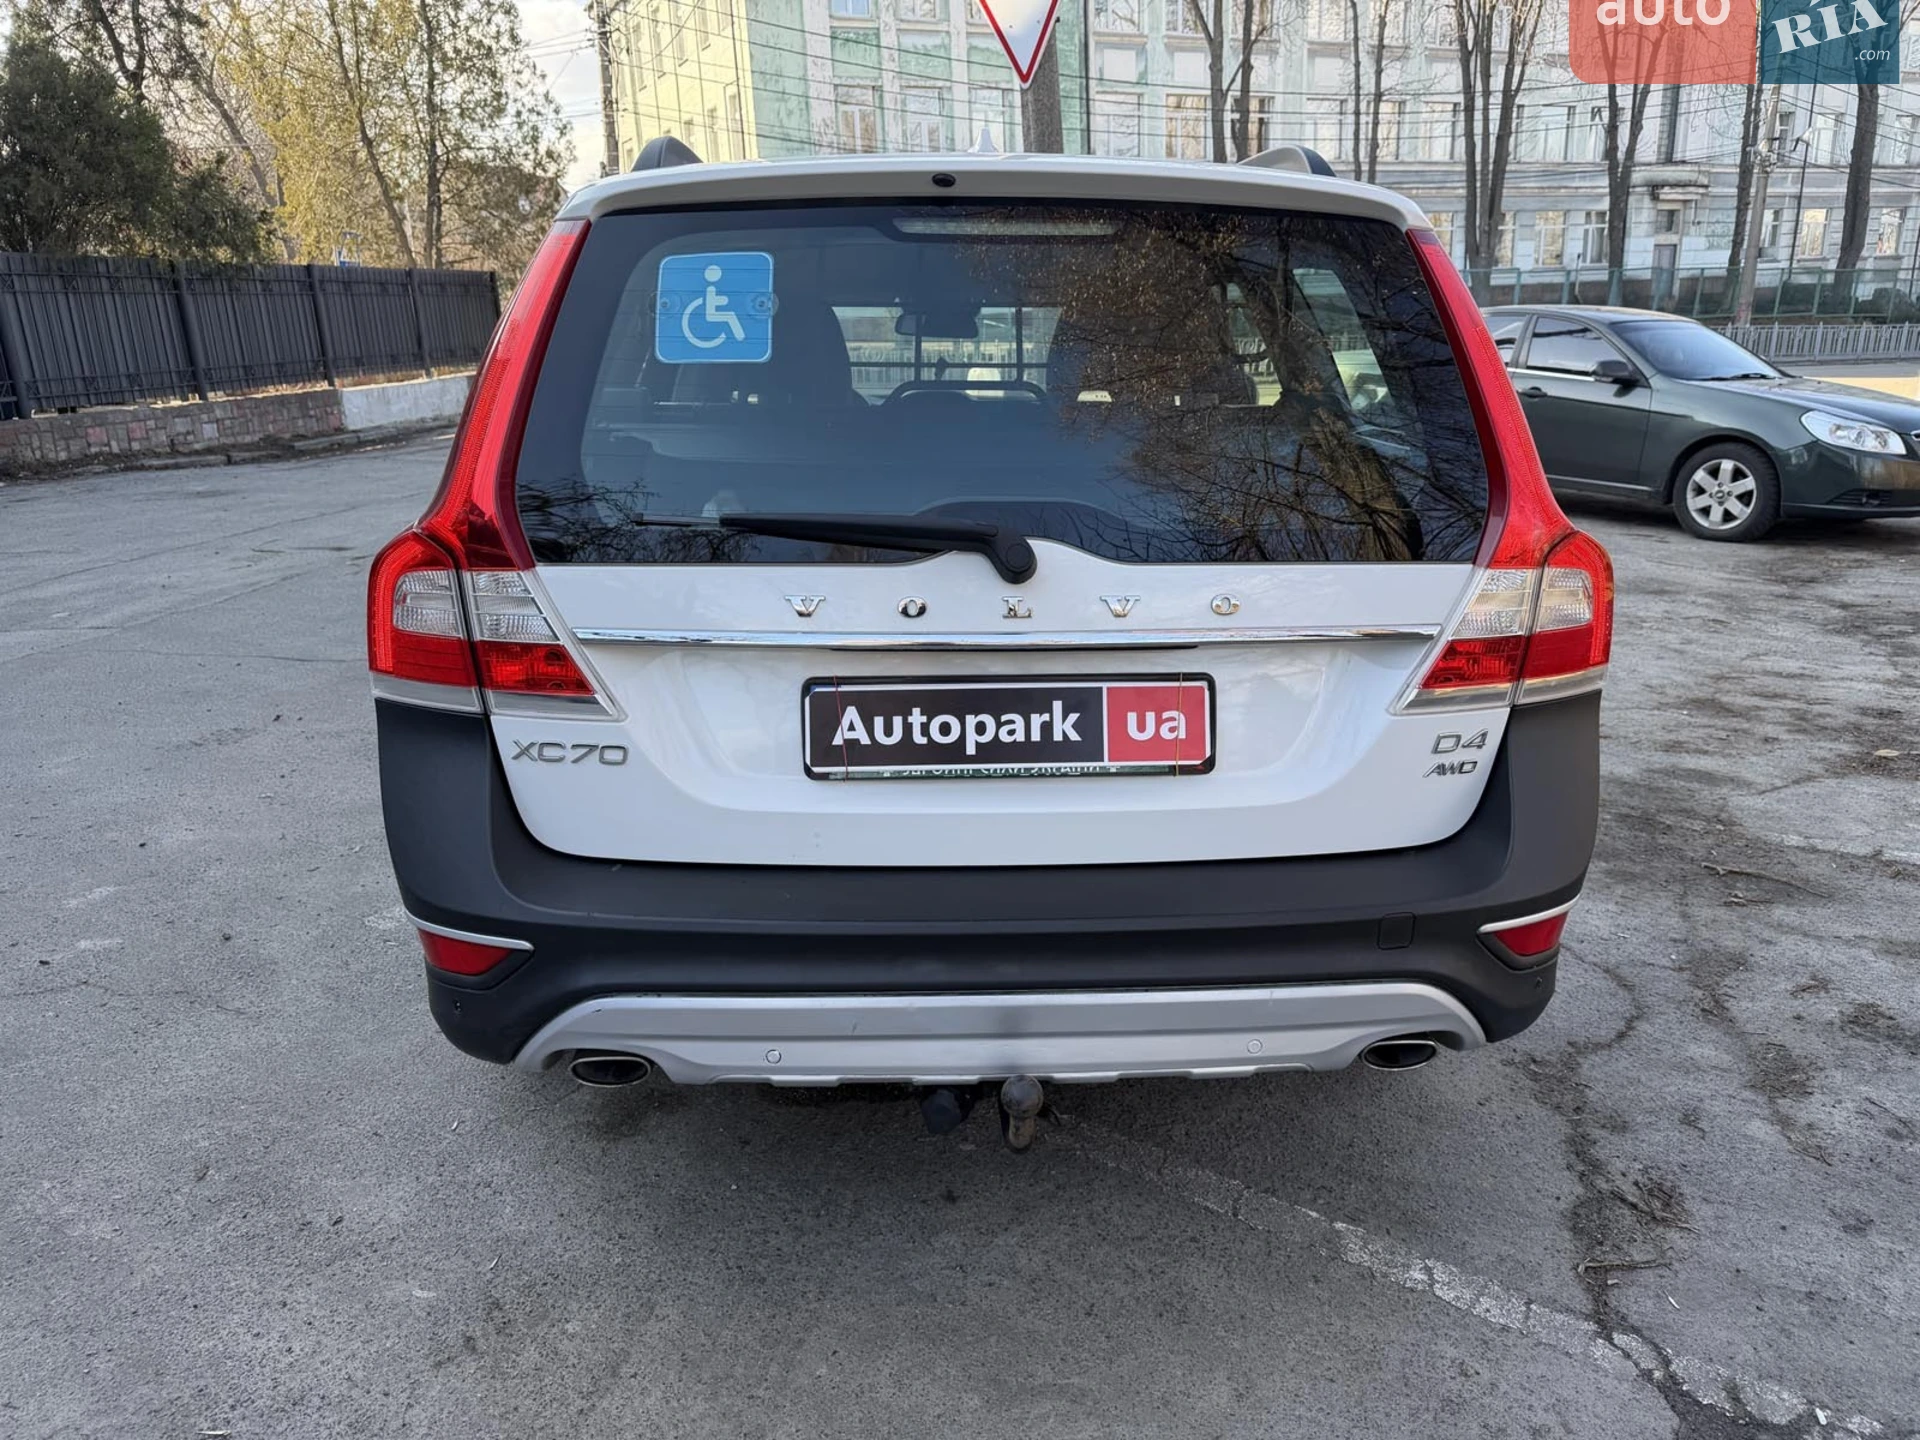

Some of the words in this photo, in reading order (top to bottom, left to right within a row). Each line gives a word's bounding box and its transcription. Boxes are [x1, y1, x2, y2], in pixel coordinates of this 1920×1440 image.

[784, 593, 1242, 619] VOLVO
[832, 700, 1083, 756] Autopark
[1126, 709, 1187, 741] ua
[1431, 728, 1489, 754] D4
[511, 739, 629, 766] XC70
[1422, 760, 1478, 778] AWD
